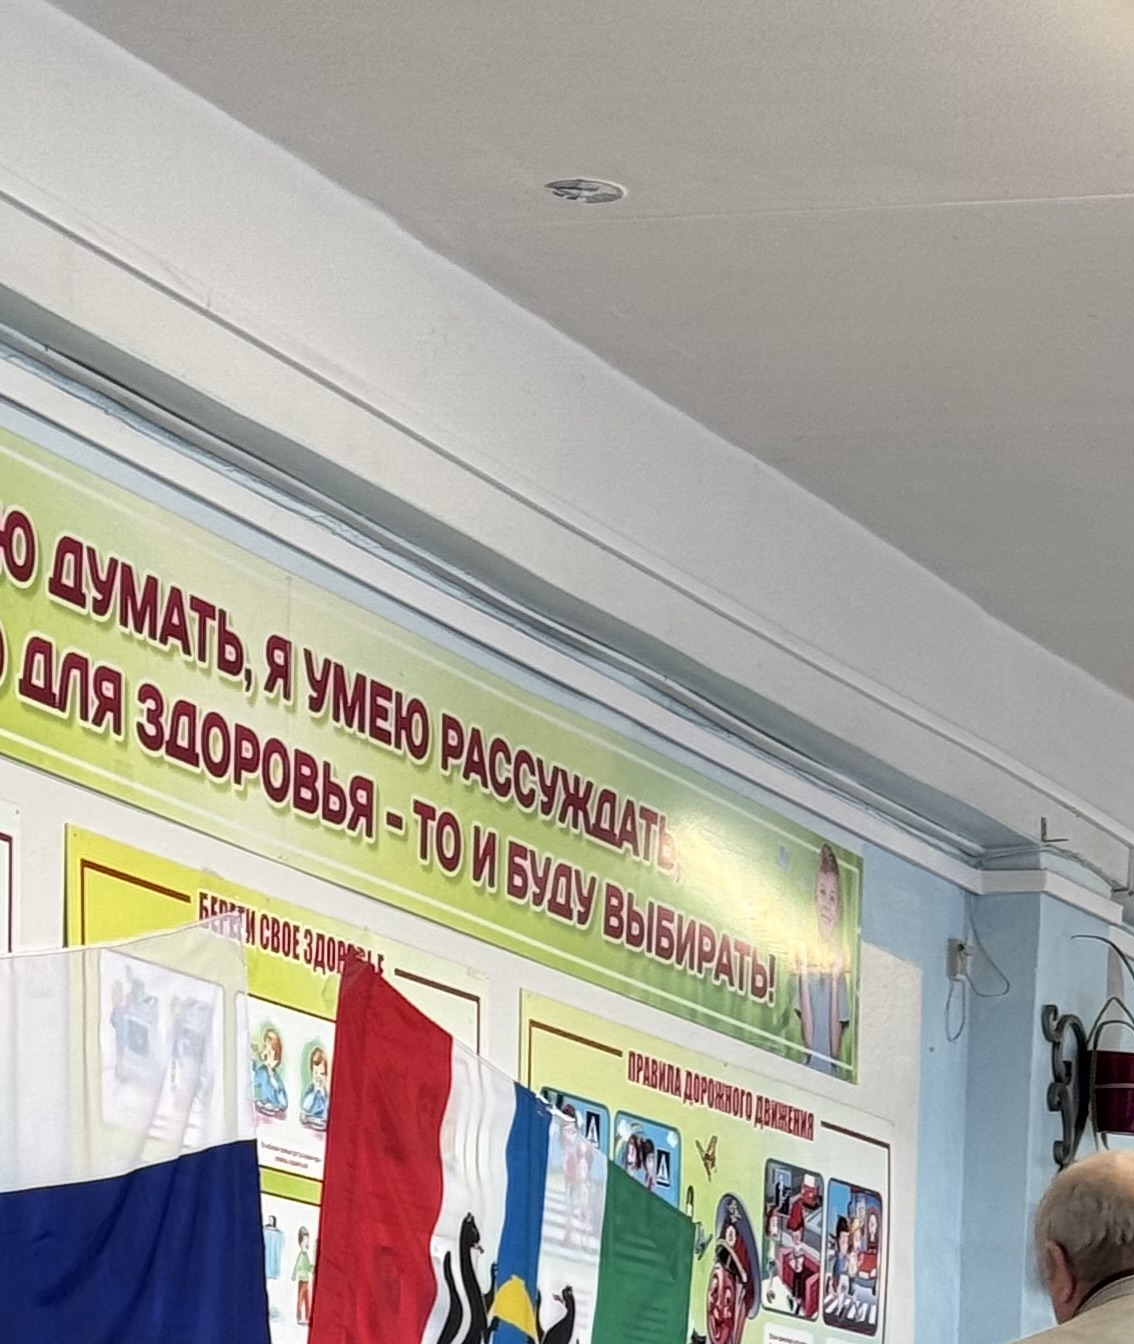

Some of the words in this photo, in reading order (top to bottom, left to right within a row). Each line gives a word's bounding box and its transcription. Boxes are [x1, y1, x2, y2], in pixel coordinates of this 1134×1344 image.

[48, 536, 252, 692] ДУМАТЬ,
[264, 634, 291, 700] Я
[303, 647, 430, 760] УМЕЮ
[441, 713, 682, 881] РАССУЖДАТЬ,
[19, 636, 122, 736] ДЛЯ
[136, 684, 374, 838] ЗДОРОВЬЯ
[386, 812, 403, 830] -
[413, 799, 462, 872] ТО
[472, 825, 496, 888] И
[507, 840, 597, 926] БУДУ
[603, 883, 776, 1001] ВЫБИРАТЬ!
[260, 914, 300, 961] СВОЕ
[628, 1051, 682, 1097] ПРАВИЛА
[683, 1070, 753, 1122] ДОРОЖНОГО
[754, 1095, 815, 1141] ДВИЖЕНИЯ
